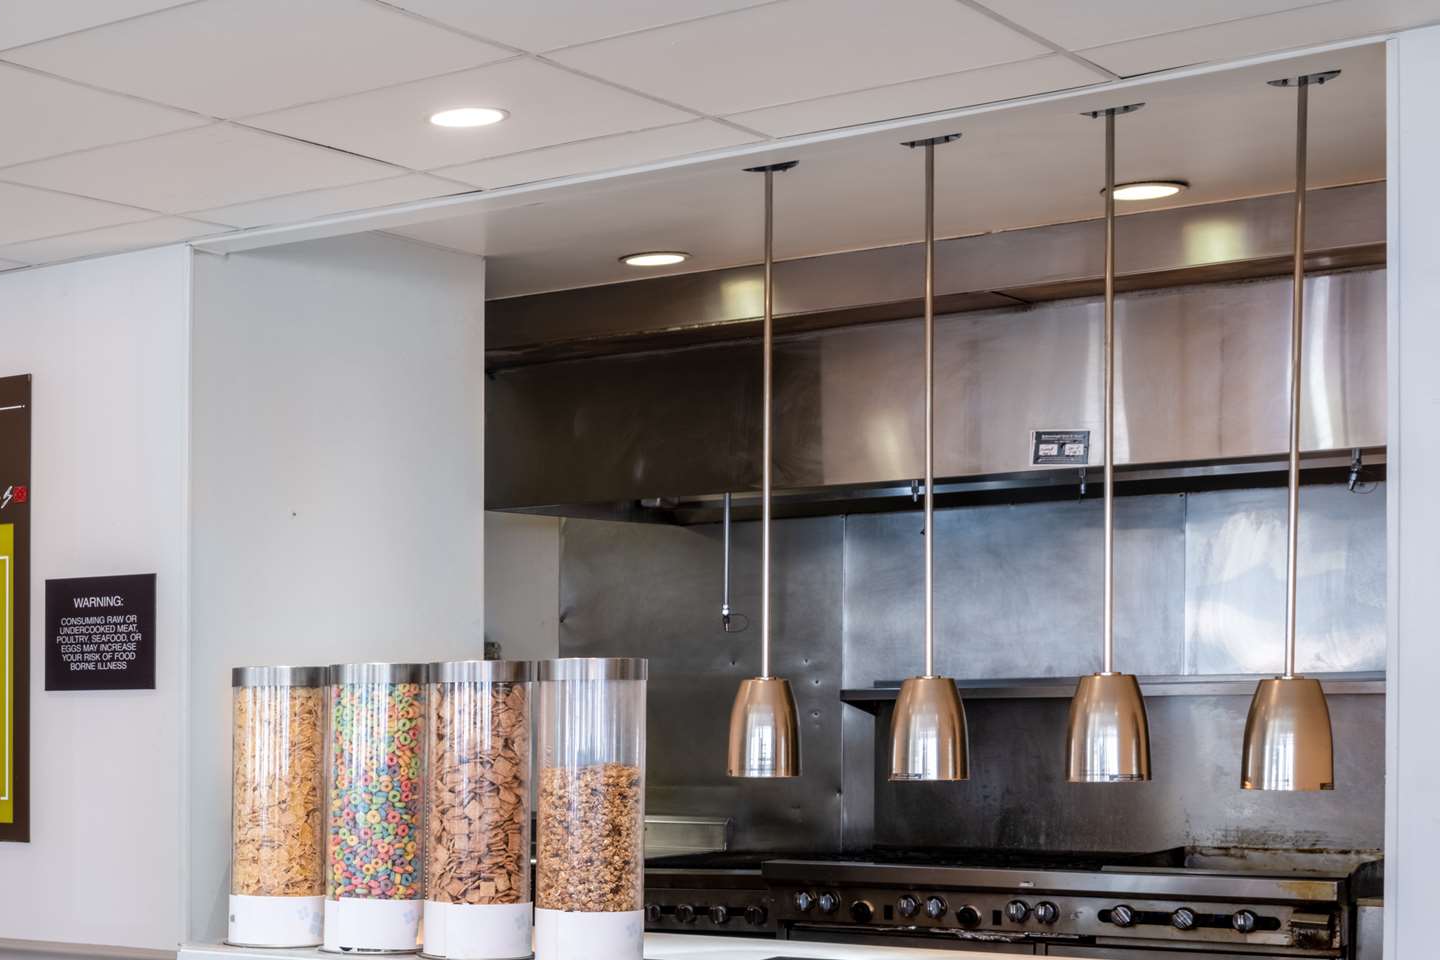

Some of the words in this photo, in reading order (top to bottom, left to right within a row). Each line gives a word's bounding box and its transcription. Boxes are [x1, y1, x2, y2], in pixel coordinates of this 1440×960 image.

[73, 595, 124, 609] WARNING:
[60, 616, 105, 626] CONSUMING
[106, 615, 125, 624] RAW
[125, 614, 138, 623] OR
[59, 625, 116, 635] UNDERCOOKED
[117, 624, 139, 633] MEAT,
[56, 635, 90, 645] POULTRY,
[91, 634, 129, 643] SEAFOOD,
[129, 632, 142, 641] OR
[61, 644, 82, 653] EGGS
[82, 644, 98, 652] MAY
[99, 642, 137, 652] INCREASE
[61, 653, 82, 662] YOUR
[83, 653, 101, 662] RISK
[102, 652, 114, 661] OF
[114, 652, 136, 661] FOOD
[70, 662, 96, 671] BORNE
[97, 661, 128, 670] ILLNESS
